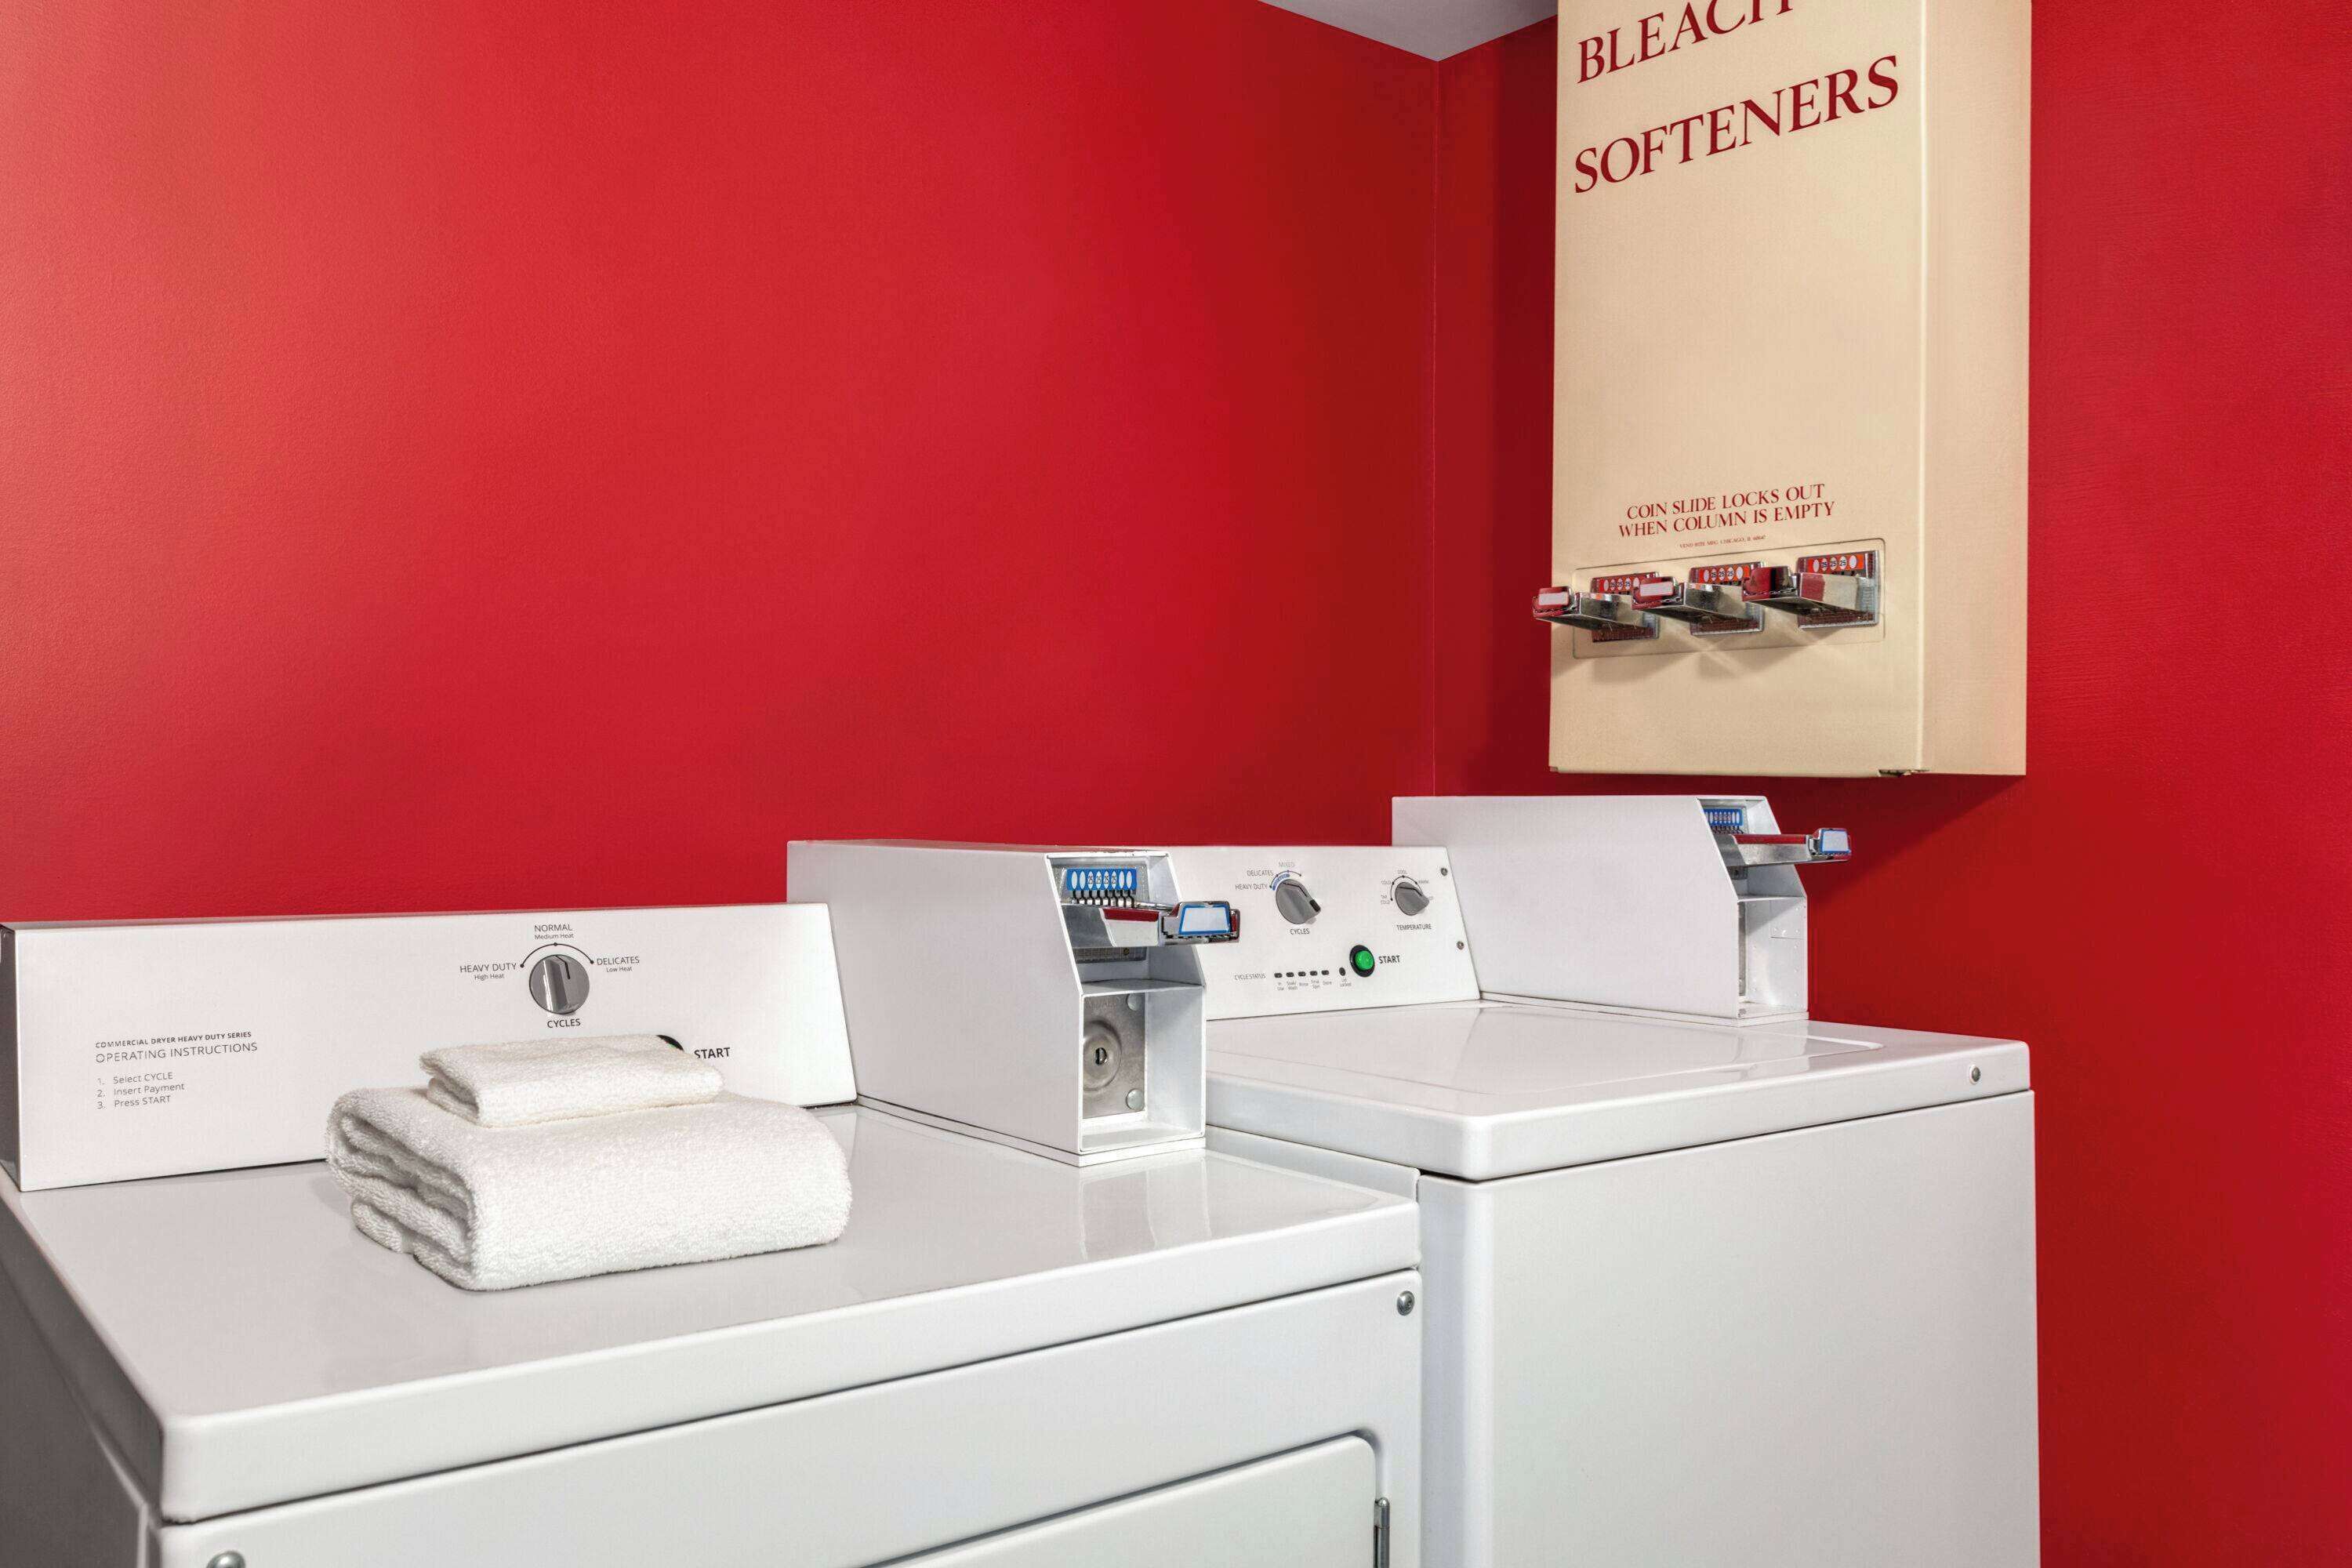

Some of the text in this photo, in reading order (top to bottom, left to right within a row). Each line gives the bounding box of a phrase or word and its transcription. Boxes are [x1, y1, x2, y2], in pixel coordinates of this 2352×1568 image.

[1574, 55, 1899, 194] SOFTENERS
[1627, 483, 1825, 520] COIN SLIDE LOCKS OUT
[1618, 501, 1836, 538] WHEN COLUMN IS EMPTY
[534, 924, 572, 932] NORMAL
[596, 956, 640, 965] DELICATES
[1378, 955, 1400, 964] START
[459, 963, 517, 974] HEAVY DUTY
[547, 1018, 581, 1029] CYCLES
[96, 1038, 148, 1048] COMMERCIAL
[151, 1036, 176, 1044] DRYER
[177, 1034, 203, 1043] HEAVY
[96, 1042, 258, 1063] OPERATING INSTRUCTIONS
[694, 1047, 731, 1059] START
[113, 1074, 142, 1084] Select
[144, 1072, 173, 1082] CYCLE
[97, 1083, 185, 1098] 2. Insert Payment
[97, 1095, 171, 1109] 3. Press START
